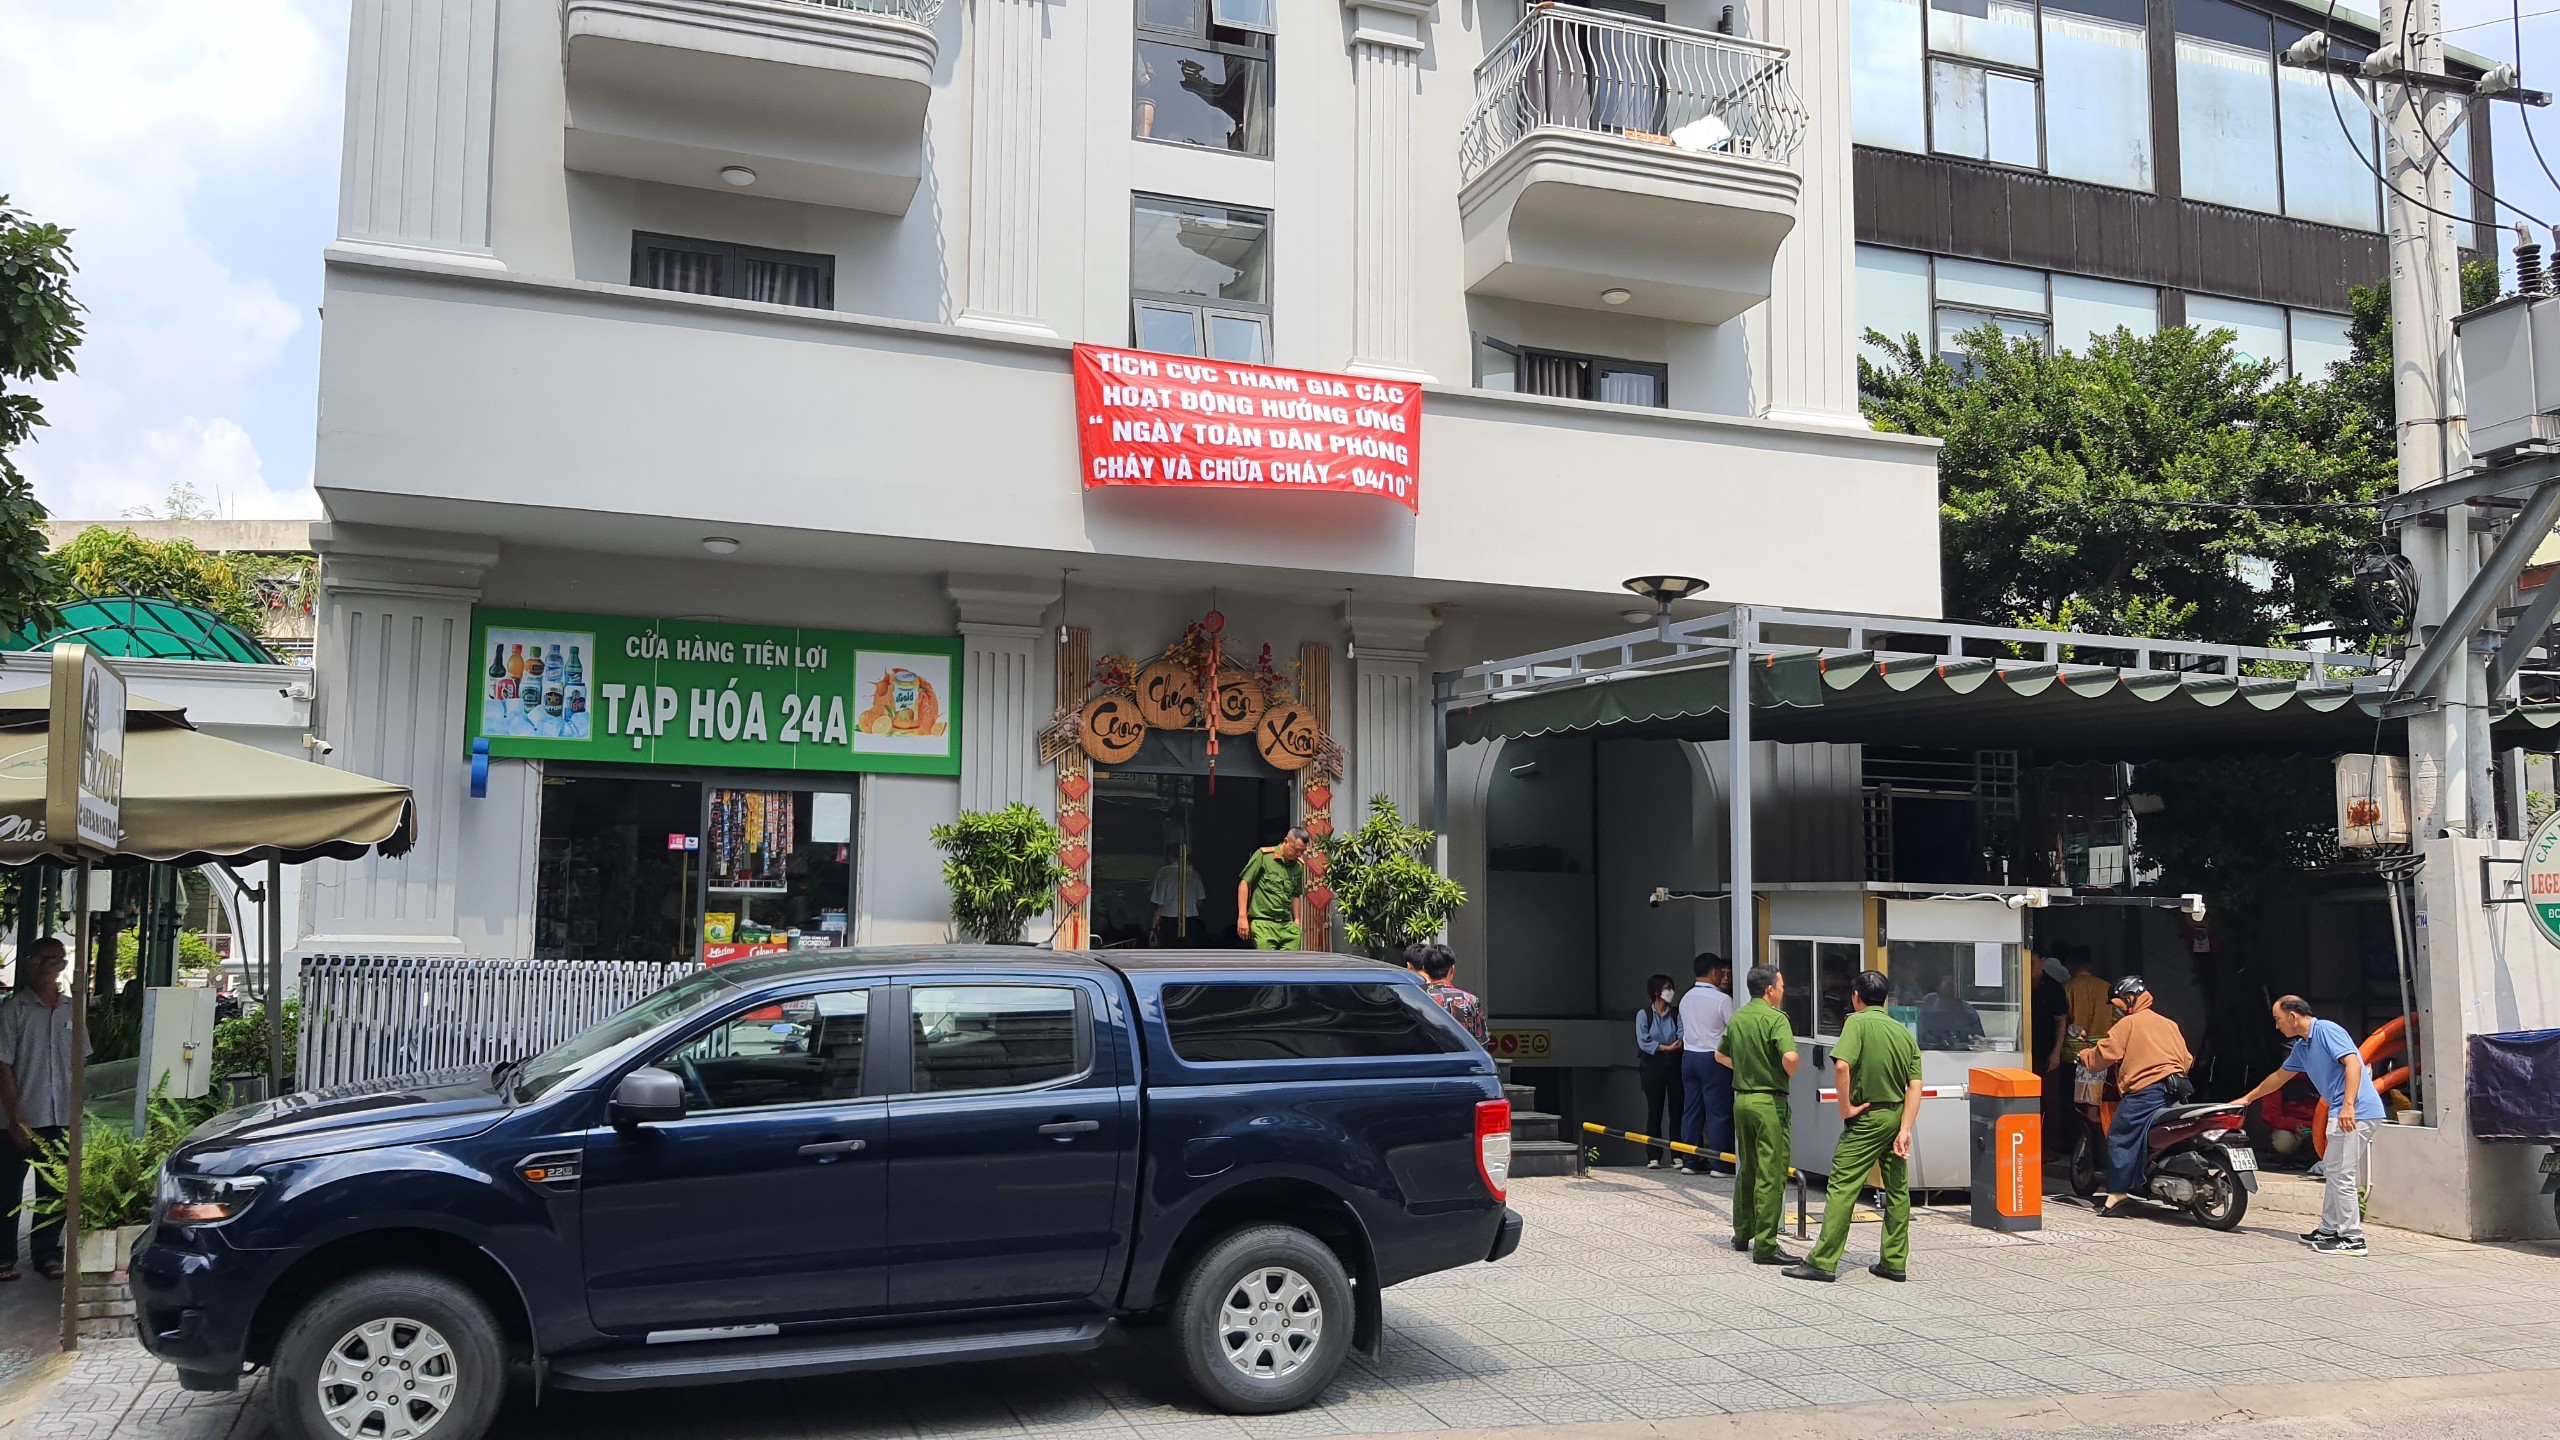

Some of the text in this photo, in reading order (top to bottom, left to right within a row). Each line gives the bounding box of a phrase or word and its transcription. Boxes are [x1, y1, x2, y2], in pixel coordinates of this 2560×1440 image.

[1096, 352, 1405, 404] TÍCH CỰC THAM GIA CÁC
[1102, 385, 1406, 434] HOẠT ĐỘNG HƯỞNG ỨNG
[1112, 417, 1184, 443] NGÀY
[1192, 423, 1262, 448] TOÀN
[1269, 428, 1323, 452] DÂN
[1329, 434, 1409, 467] PHÒNG
[1093, 453, 1155, 480] CHÁY
[1161, 454, 1193, 480] VÀ
[1200, 456, 1264, 482] CHỮA
[1270, 460, 1330, 484] CHÁY
[625, 629, 828, 675] CỬA HÀNG TIỆN LỢI
[602, 677, 849, 749] TẠP HÓA 24A
[1090, 701, 1143, 749] Cung
[1149, 676, 1195, 717] Chúc
[1264, 711, 1315, 758] Xuân
[706, 946, 735, 959] Merino
